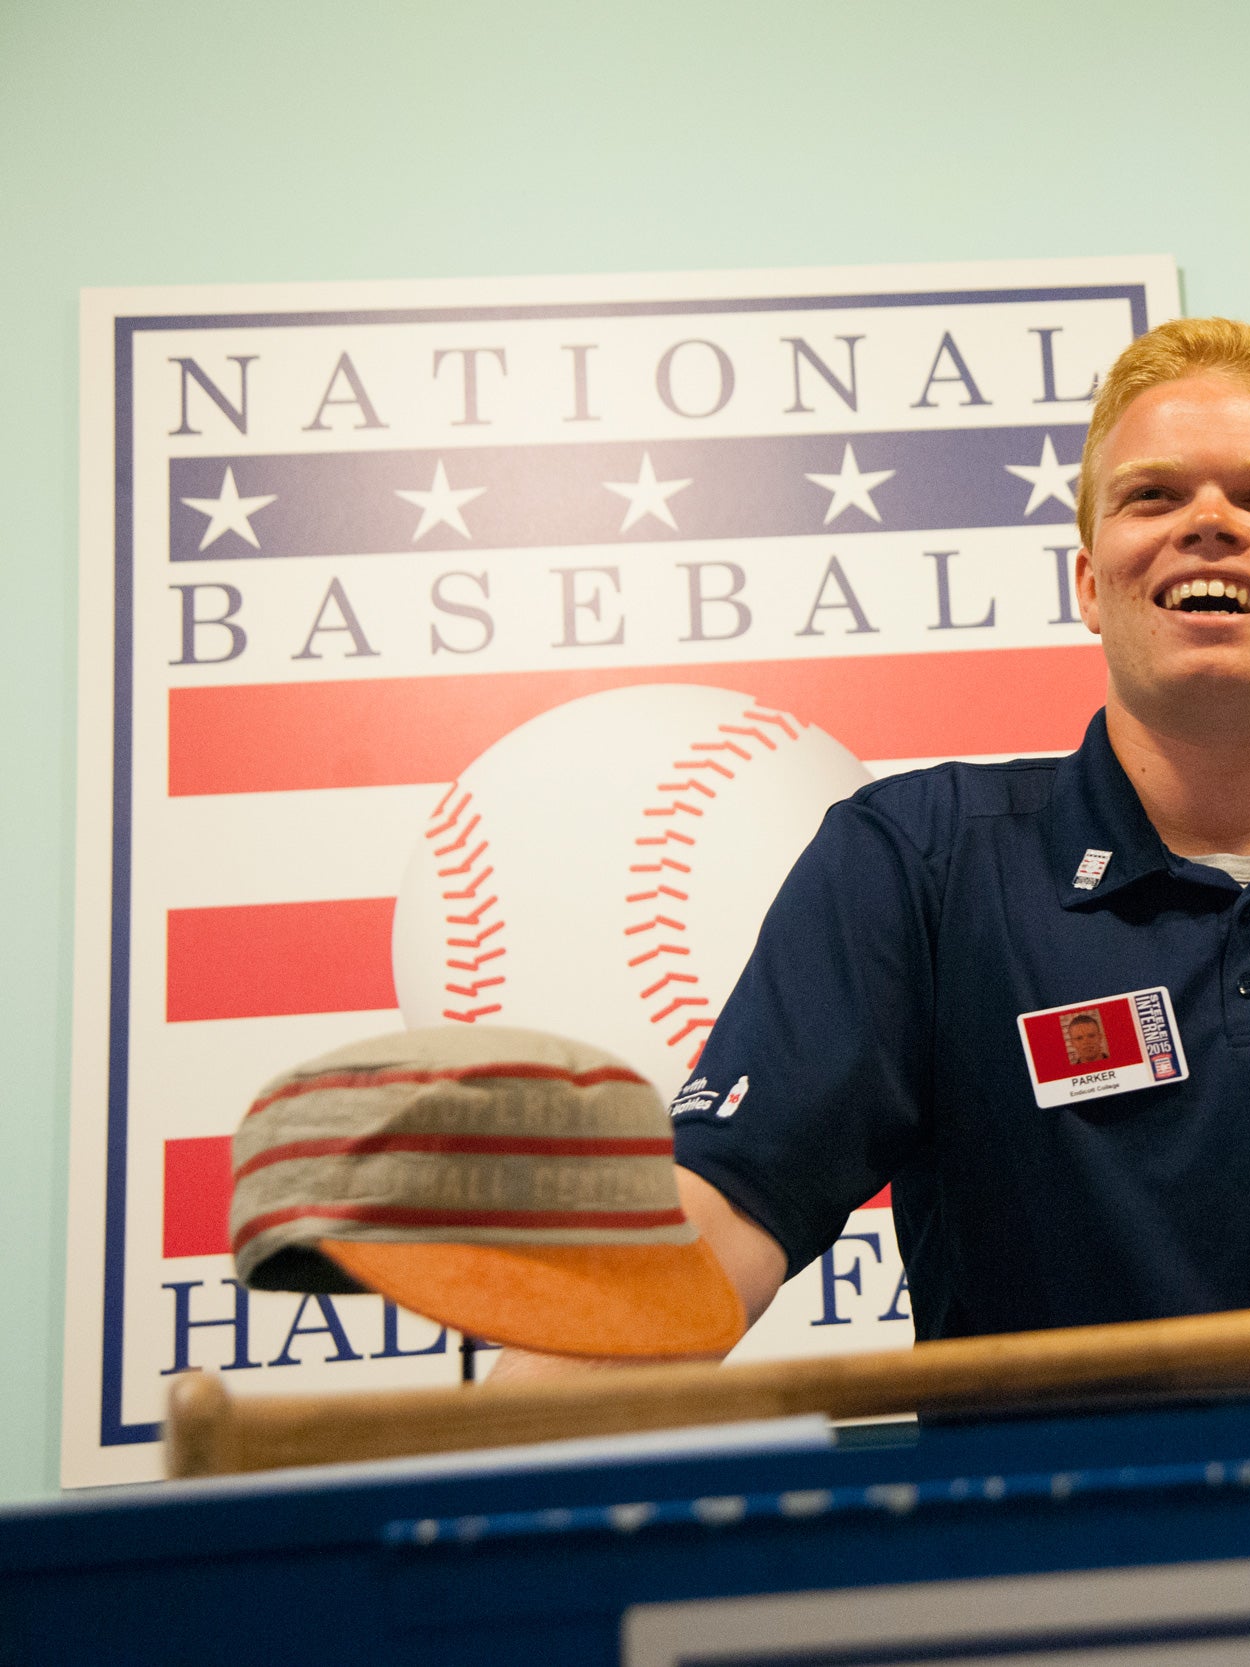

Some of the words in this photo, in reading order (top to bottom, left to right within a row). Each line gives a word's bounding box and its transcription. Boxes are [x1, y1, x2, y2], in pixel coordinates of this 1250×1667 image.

[167, 326, 1099, 437] NATIONAL
[1135, 995, 1160, 1041] INTERN
[1150, 994, 1169, 1039] STEELE
[1147, 1041, 1172, 1056] 2015
[1071, 1070, 1117, 1087] PARKER
[160, 1278, 504, 1376] HAL
